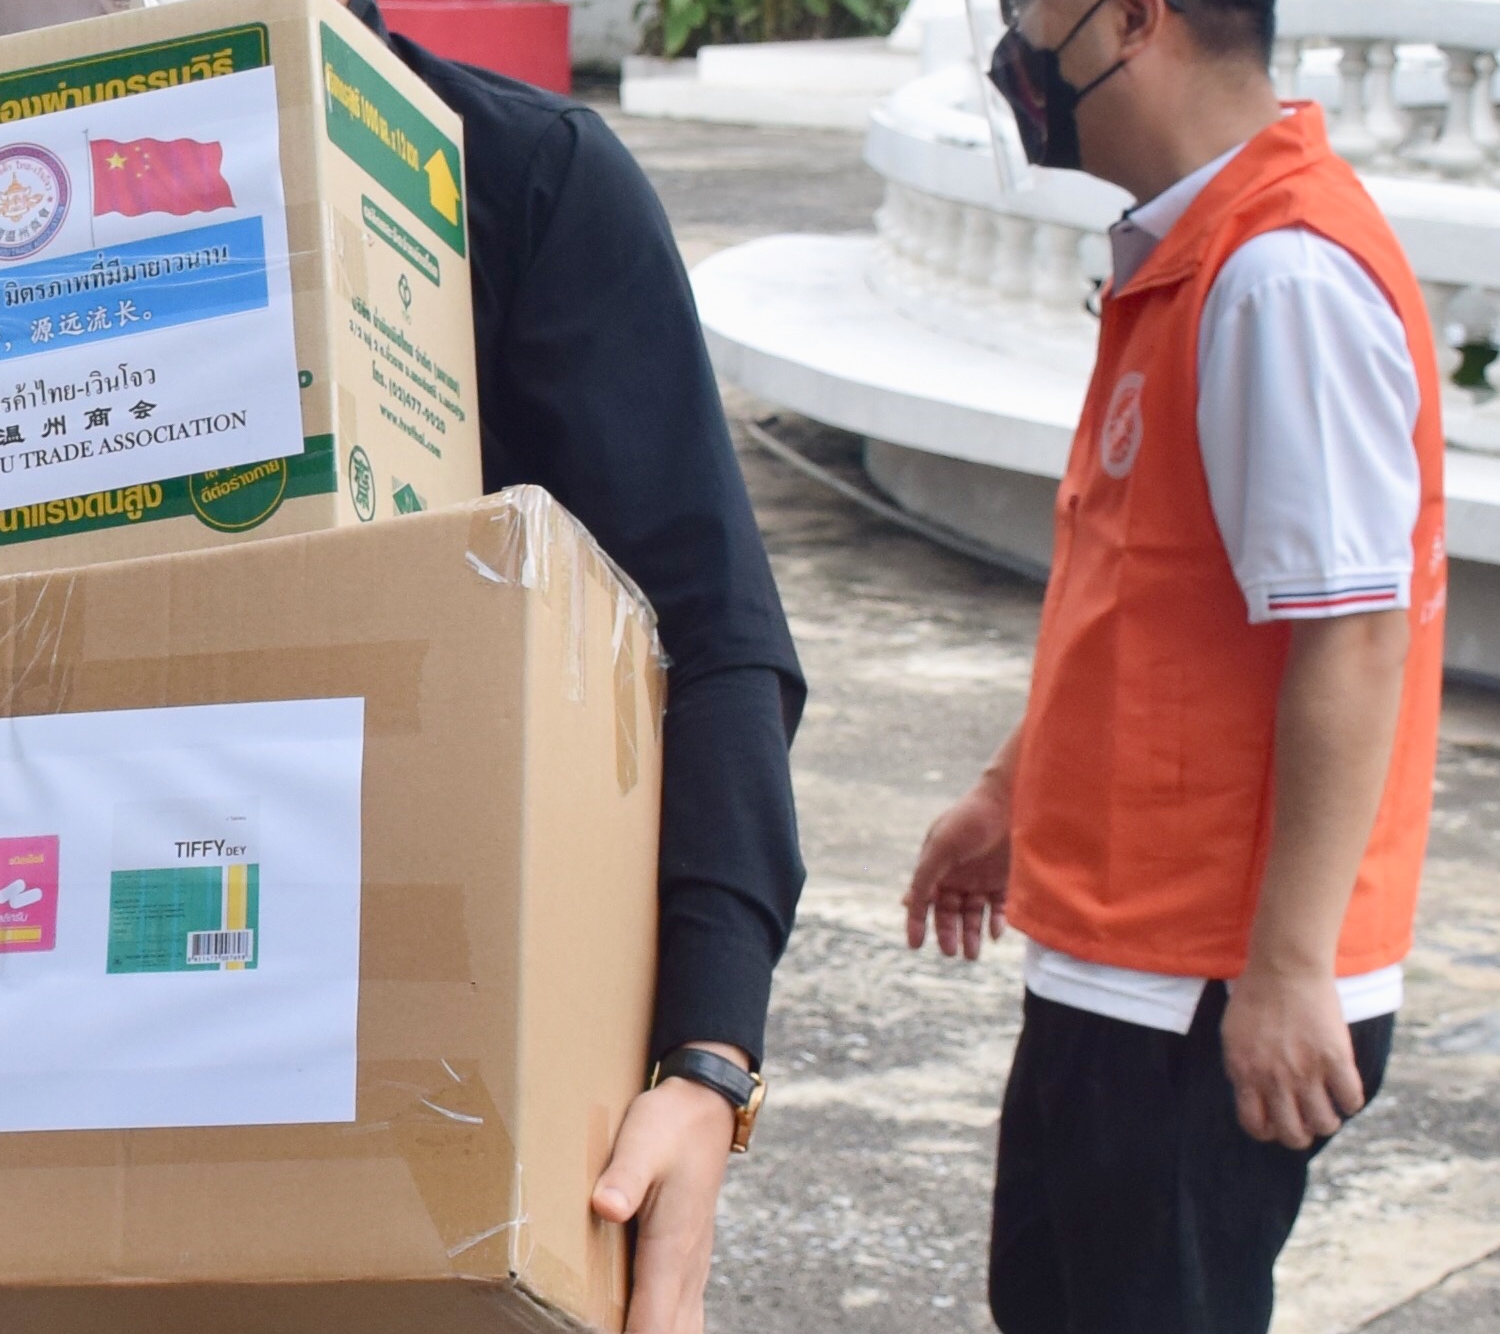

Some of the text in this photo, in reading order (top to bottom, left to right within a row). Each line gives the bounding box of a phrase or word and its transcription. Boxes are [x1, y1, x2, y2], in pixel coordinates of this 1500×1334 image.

[4, 244, 228, 308] มิตรภาพที่มีมายาวนาน
[19, 440, 95, 474] TRADE
[99, 410, 248, 454] ASSOCIATION
[174, 839, 247, 858] TIFFY DEY
